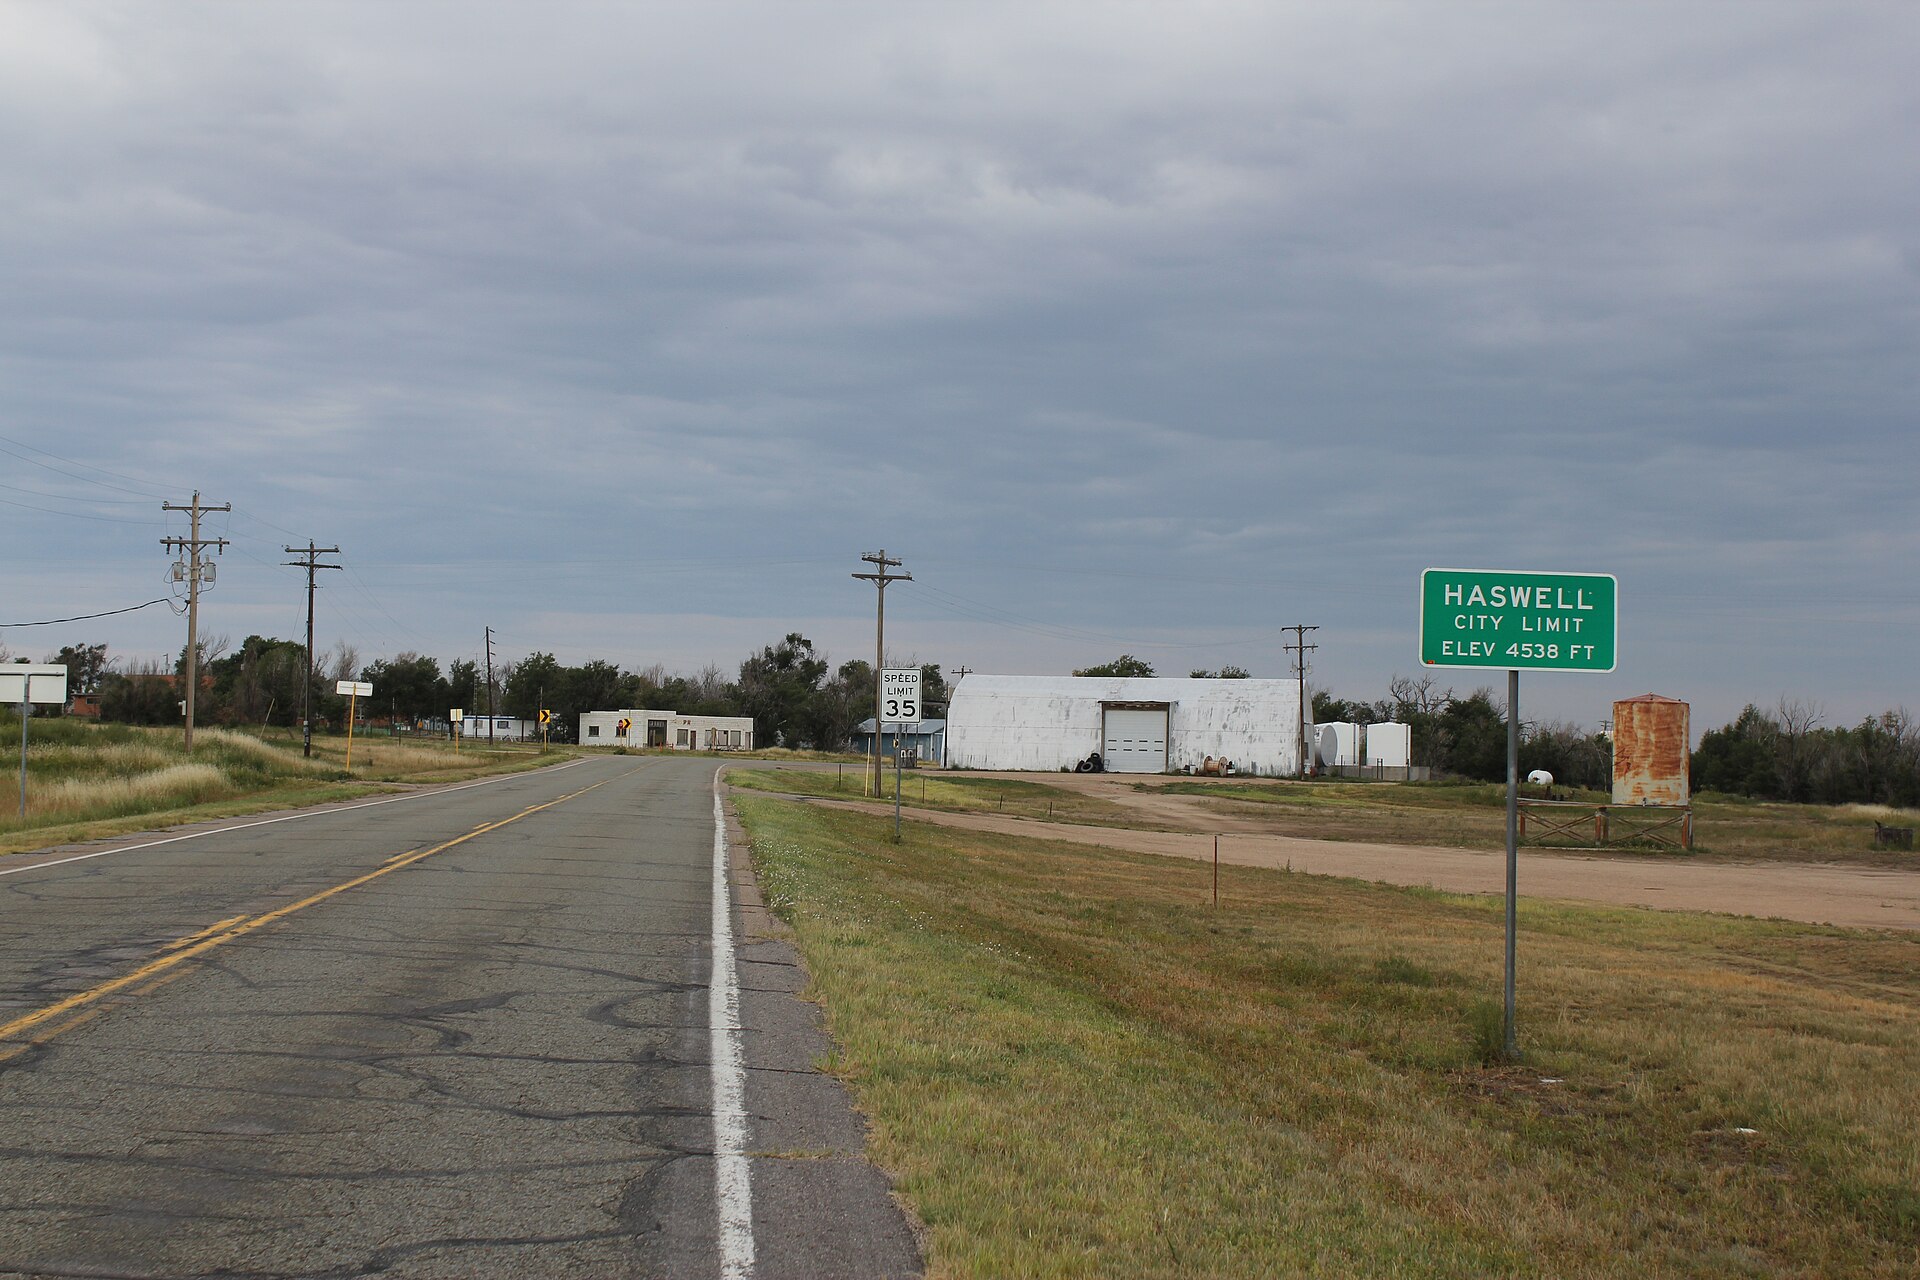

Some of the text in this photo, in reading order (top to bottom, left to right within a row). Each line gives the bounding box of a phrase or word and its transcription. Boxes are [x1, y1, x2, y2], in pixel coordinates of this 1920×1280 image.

[1444, 583, 1594, 610] HASWELL
[1454, 614, 1584, 632] CITY LIMIT
[1442, 640, 1595, 660] ELEV 4538 FT
[884, 674, 918, 683] SPEED
[887, 687, 914, 695] LIMIT
[885, 699, 916, 717] 35
